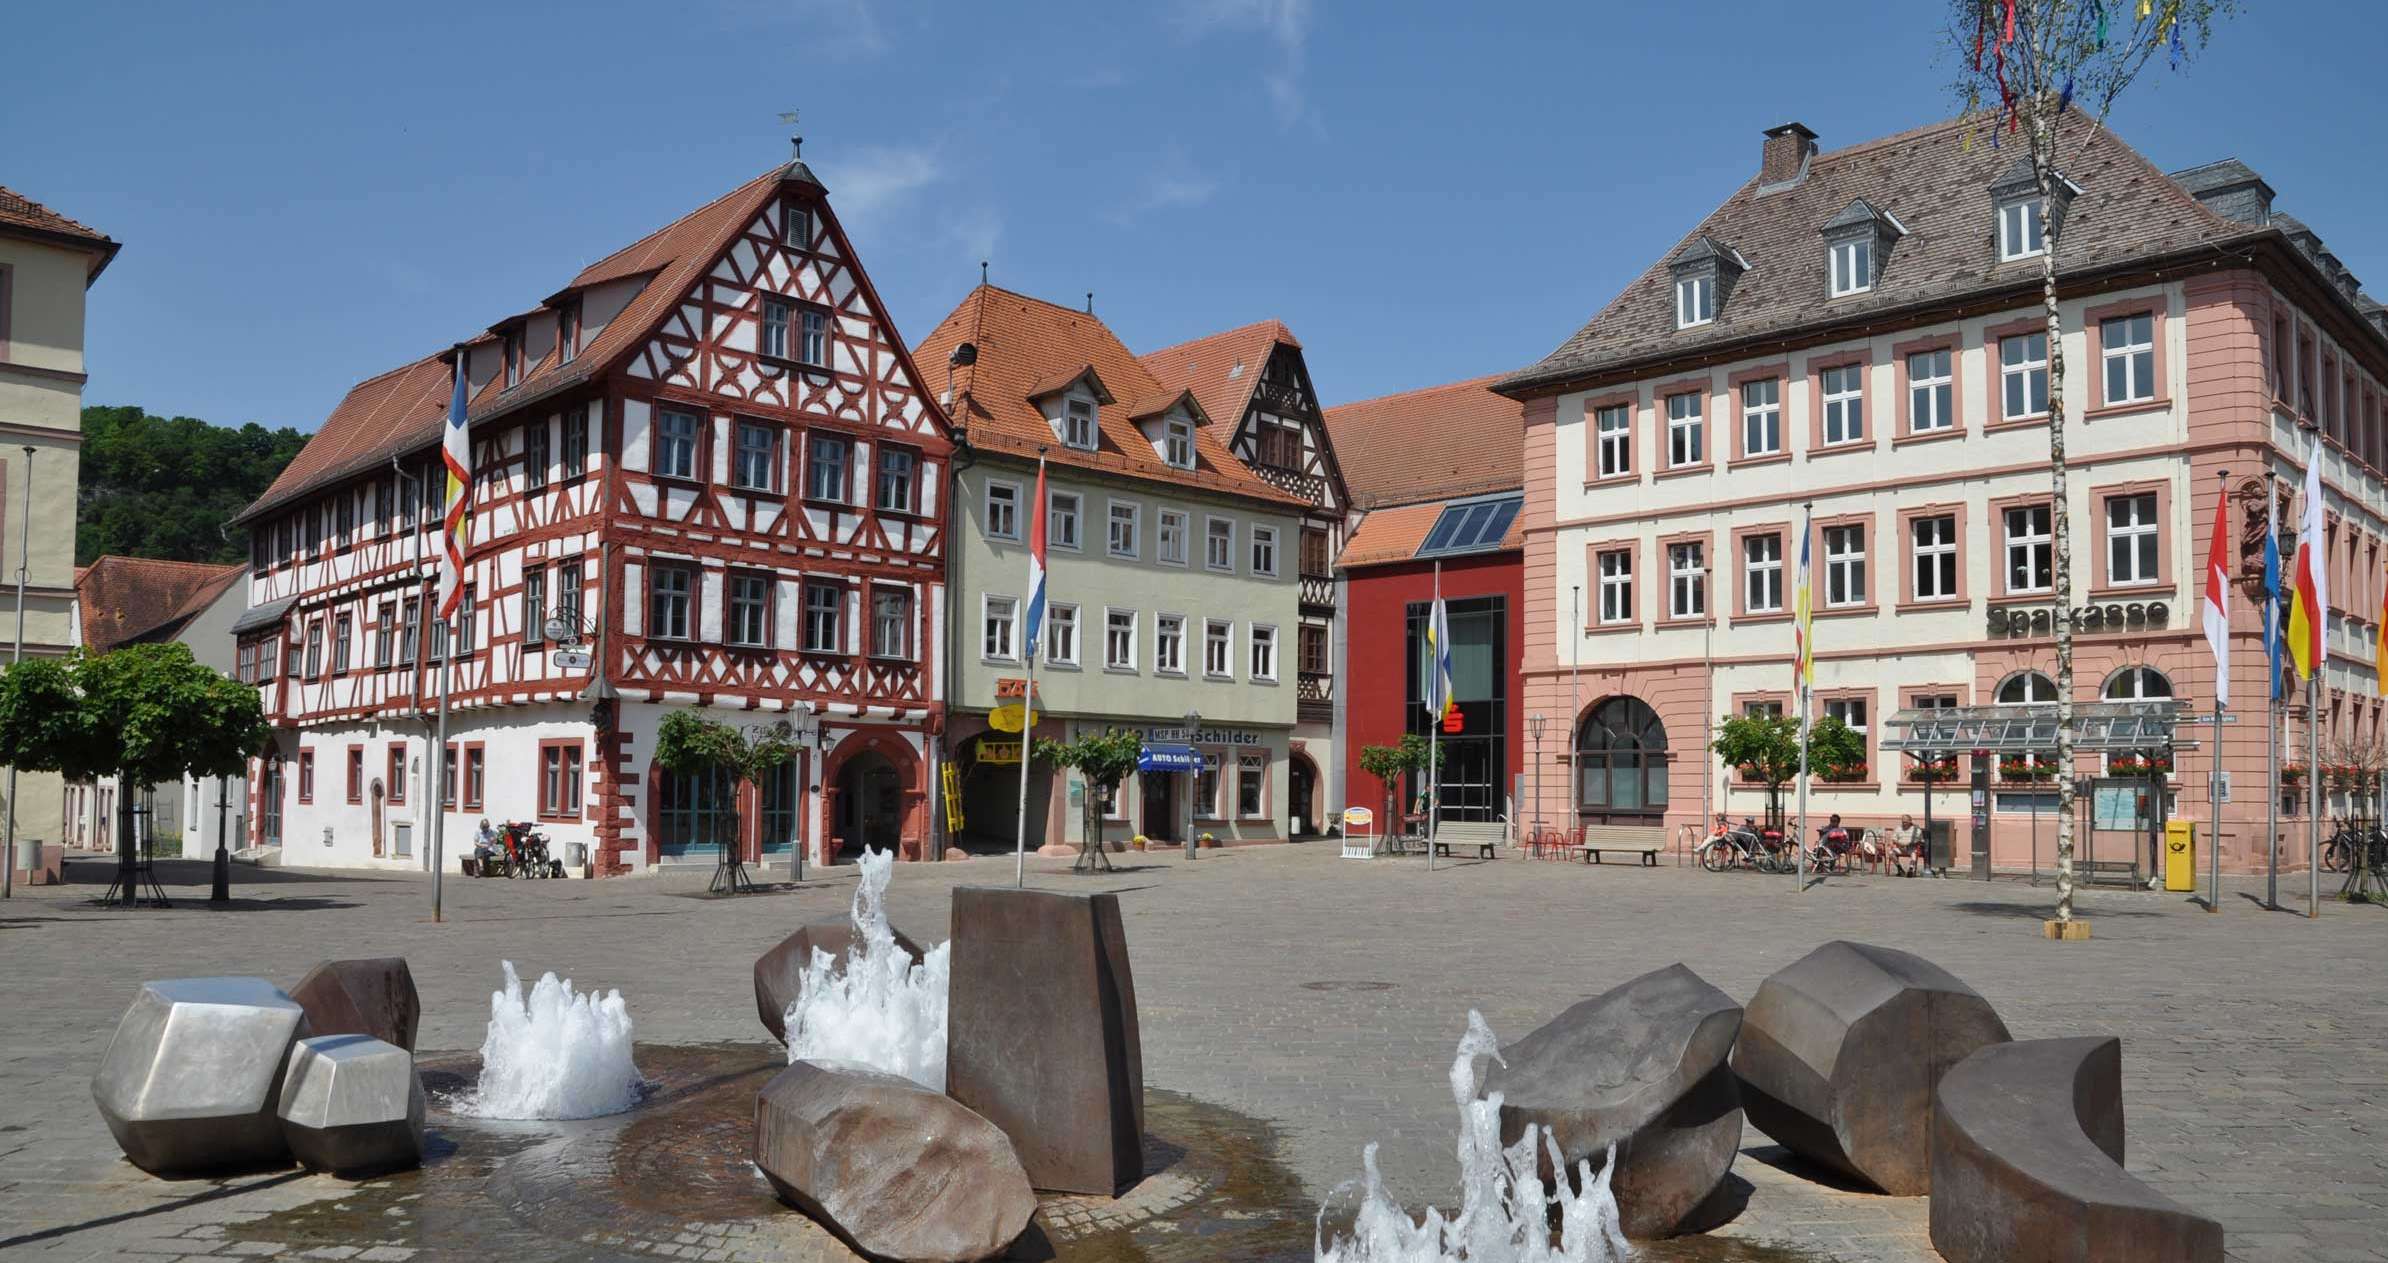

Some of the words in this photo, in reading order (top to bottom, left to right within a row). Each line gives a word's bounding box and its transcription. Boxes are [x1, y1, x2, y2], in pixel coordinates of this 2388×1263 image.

[1986, 602, 2169, 638] Spakasse
[1152, 753, 1172, 763] AUTO
[1172, 754, 1201, 764] Schiler
